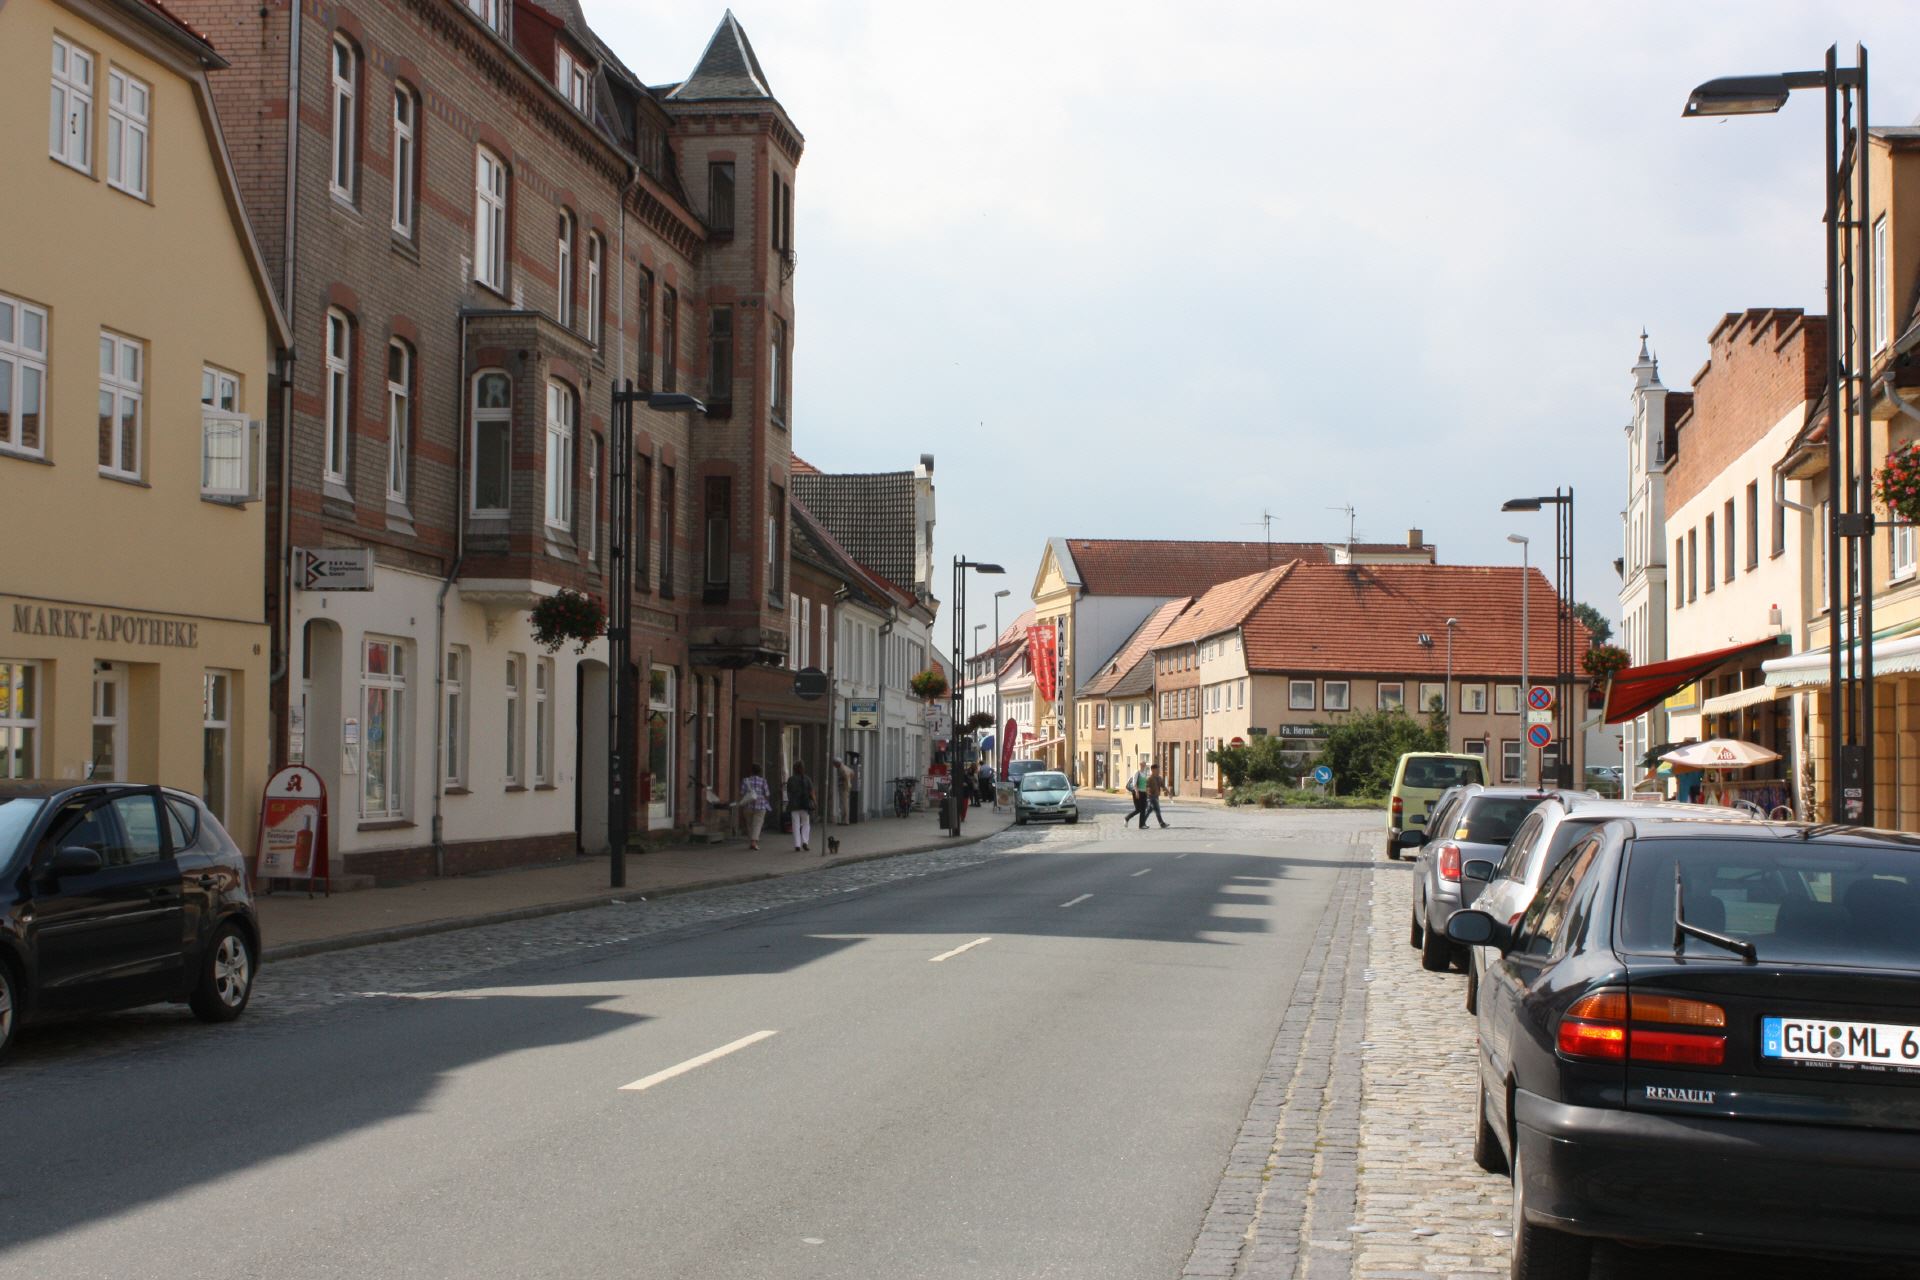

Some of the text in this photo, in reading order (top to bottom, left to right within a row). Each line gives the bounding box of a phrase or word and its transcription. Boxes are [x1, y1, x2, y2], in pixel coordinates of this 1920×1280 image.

[13, 603, 199, 649] MARKT-APOTHEKE
[1282, 725, 1319, 735] Fa. Herma
[1849, 1026, 1891, 1059] ML
[1646, 1085, 1716, 1104] RENAULT
